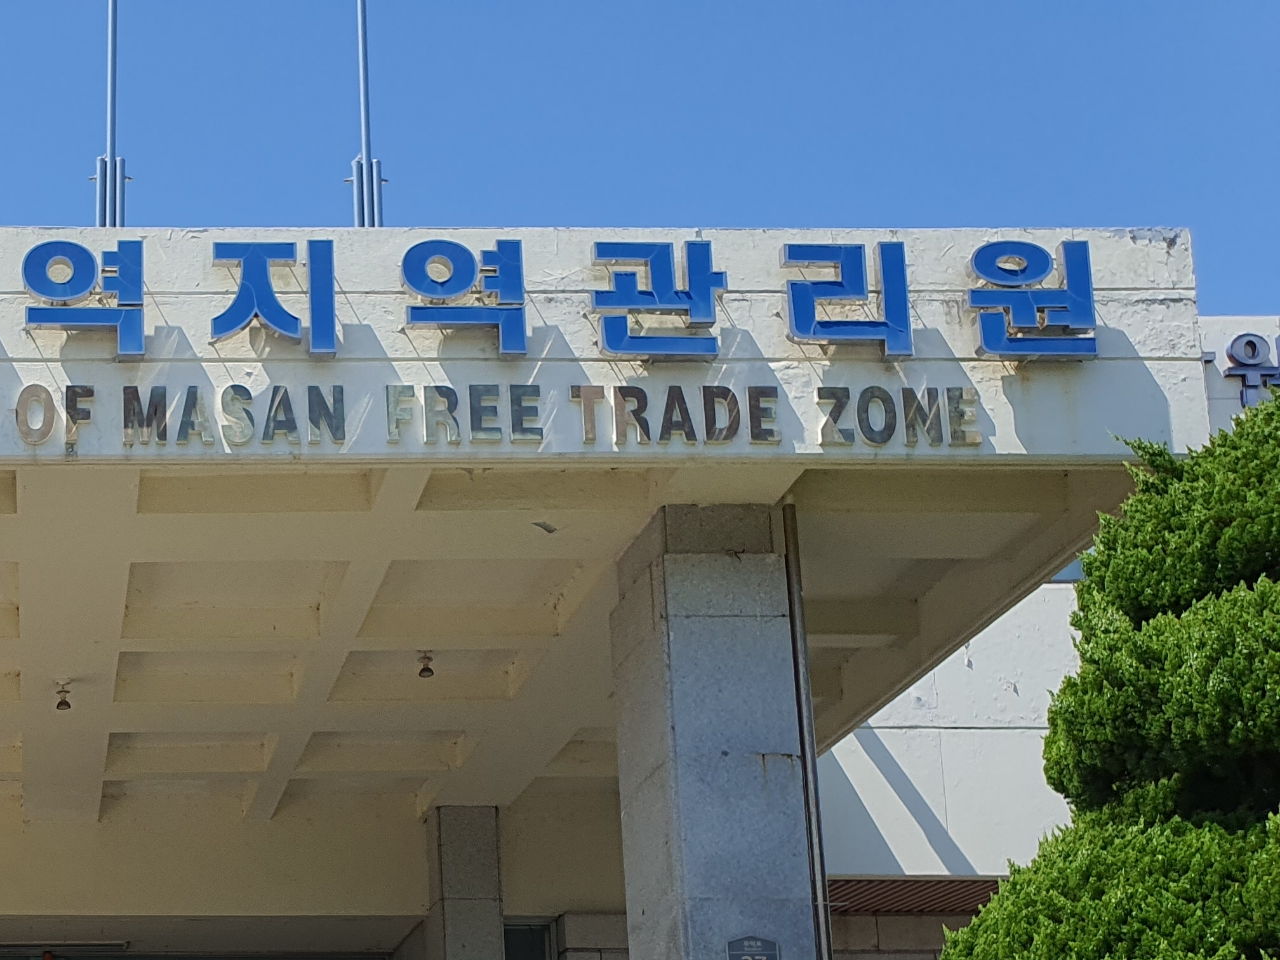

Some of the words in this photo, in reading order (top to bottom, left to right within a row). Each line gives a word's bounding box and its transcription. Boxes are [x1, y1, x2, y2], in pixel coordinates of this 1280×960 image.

[16, 383, 95, 446] OF
[122, 384, 346, 446] MASAN
[385, 384, 544, 446] FREE
[570, 385, 781, 446] TRADE
[816, 385, 982, 447] ZONE
